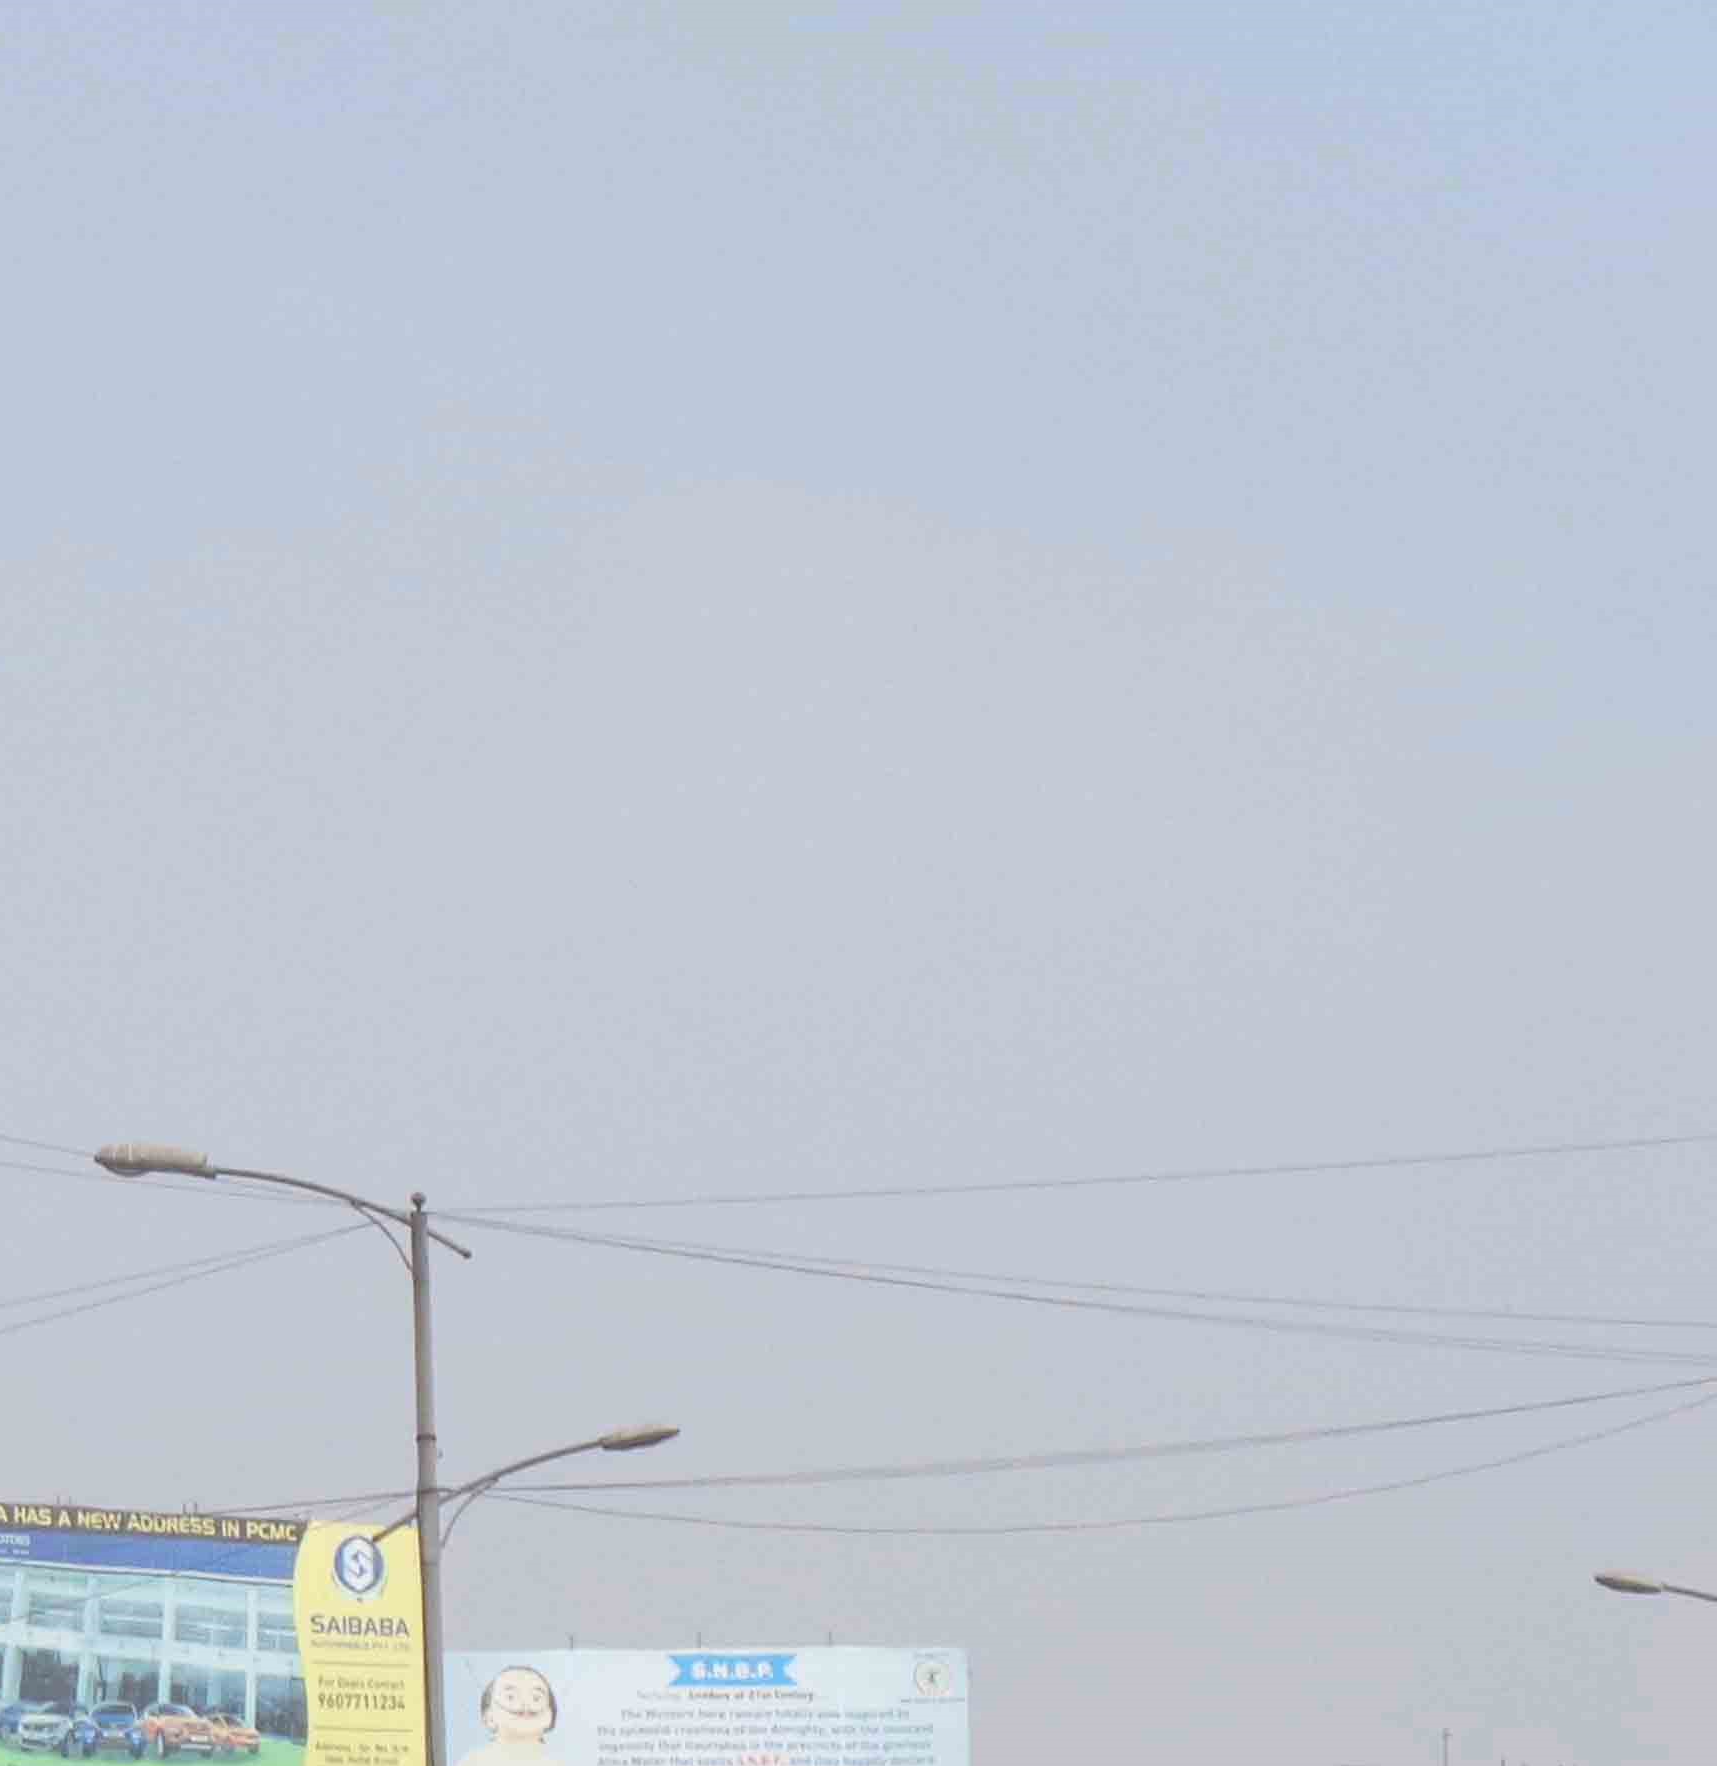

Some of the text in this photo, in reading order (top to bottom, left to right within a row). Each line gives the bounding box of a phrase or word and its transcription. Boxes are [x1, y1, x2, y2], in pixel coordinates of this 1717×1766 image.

[14, 1504, 52, 1527] HAS
[58, 1510, 72, 1528] A
[77, 1509, 122, 1531] NEW
[128, 1514, 216, 1537] ADDRESS
[223, 1519, 240, 1538] IN
[246, 1521, 298, 1542] PCMC
[310, 1614, 411, 1638] SAIBABA
